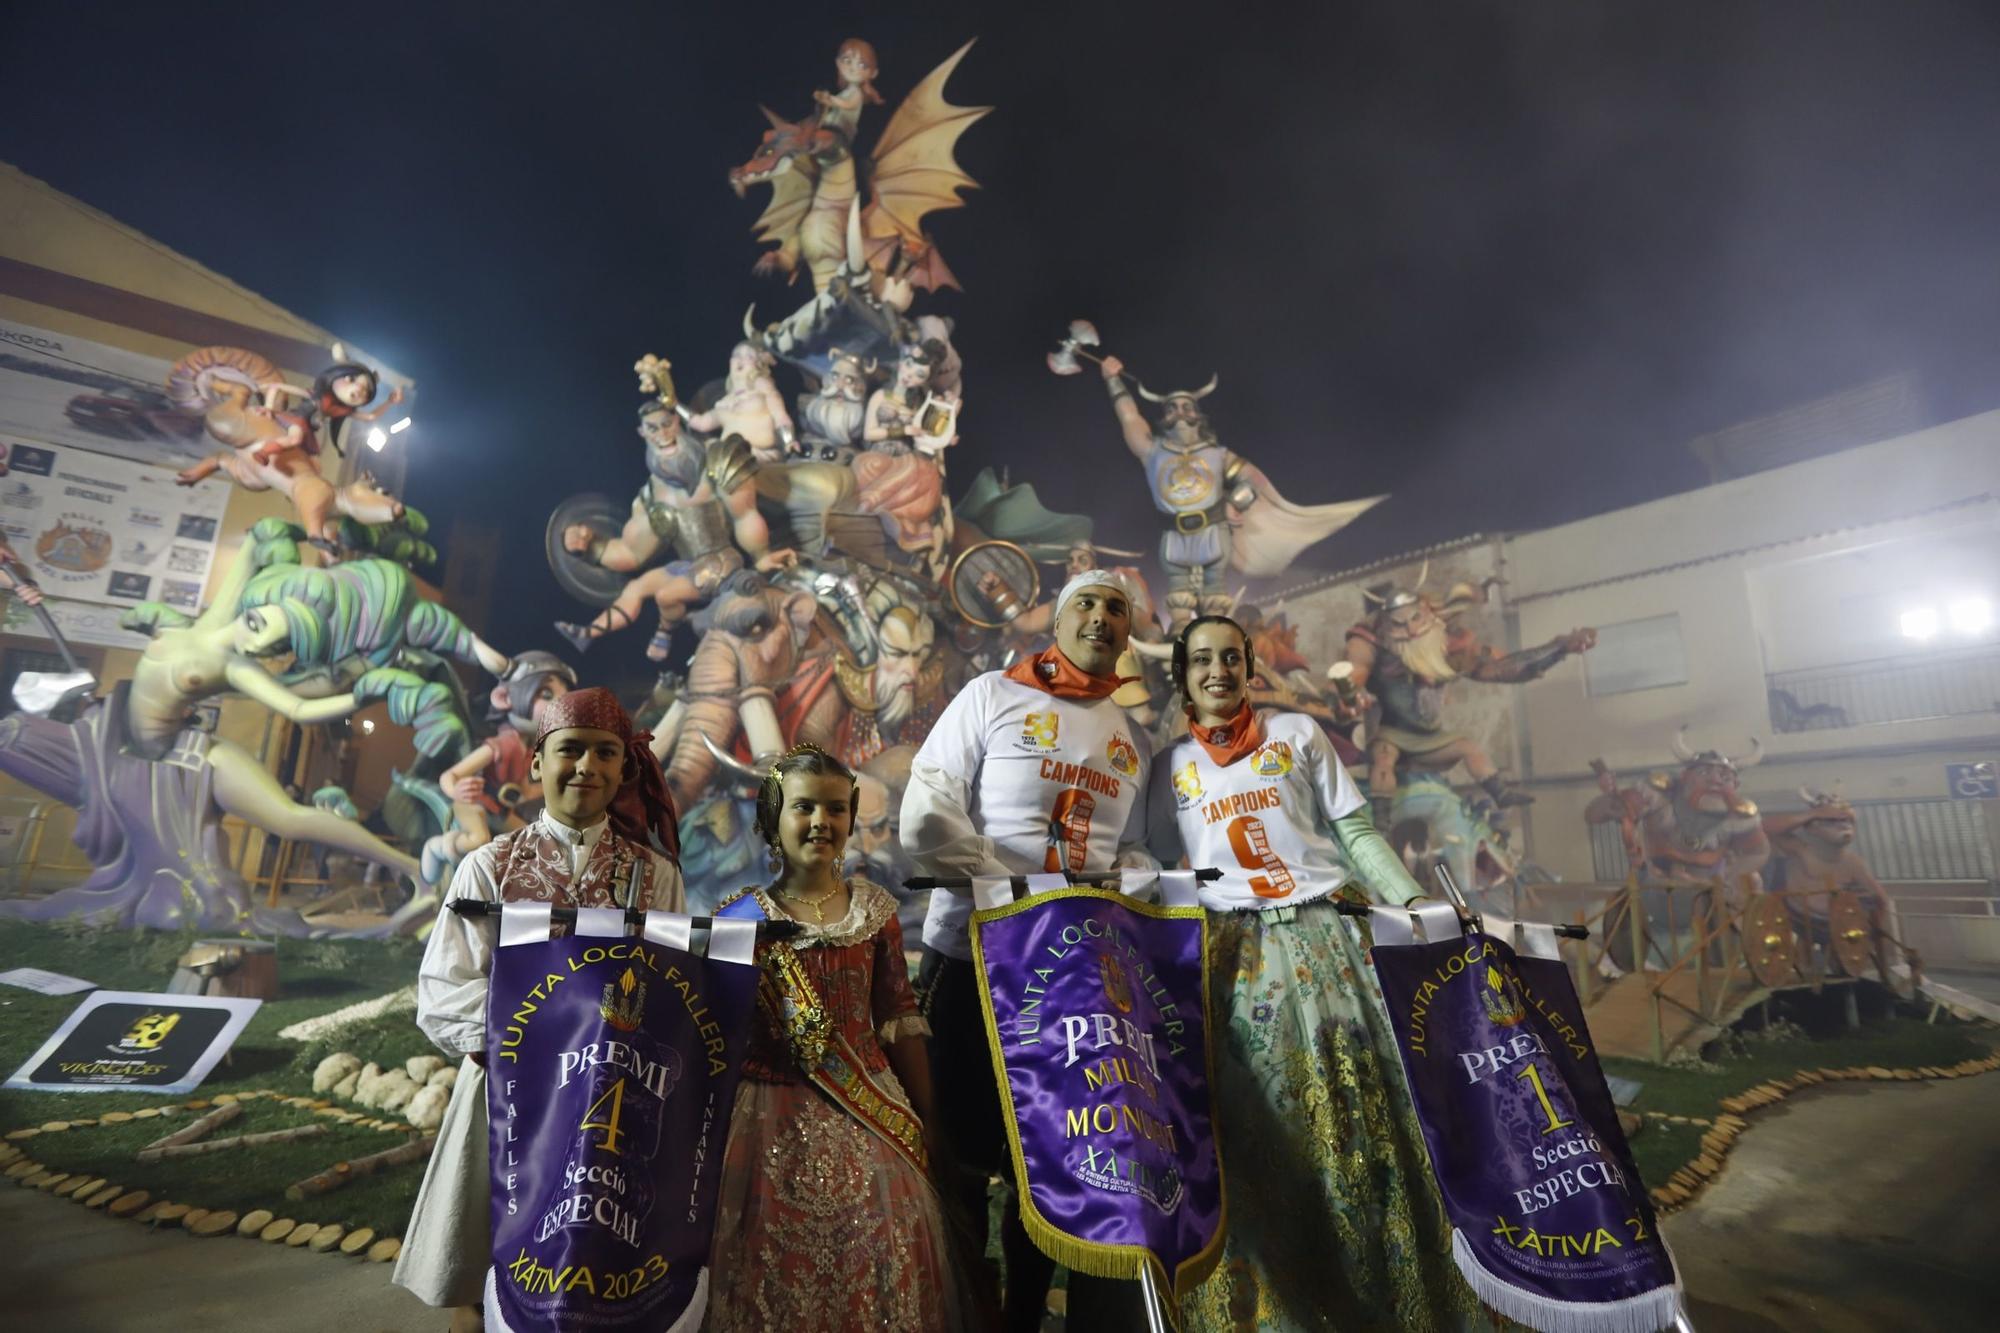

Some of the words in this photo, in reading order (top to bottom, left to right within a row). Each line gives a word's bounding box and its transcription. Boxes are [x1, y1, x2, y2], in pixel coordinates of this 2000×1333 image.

[1040, 757, 1120, 798] CAMPIONS
[1201, 786, 1281, 825] CAMPIONS
[499, 973, 565, 1064] JUNTA
[567, 944, 659, 973] LOCAL
[664, 966, 728, 1077] FALLERA
[1018, 968, 1055, 1046] JUNTA
[1047, 918, 1123, 959] LOCAL
[1127, 945, 1186, 1056] FALLERA
[1410, 980, 1440, 1058] JUNTA
[1436, 941, 1498, 983] LOCA
[558, 1040, 671, 1101] PREMI
[1458, 1033, 1551, 1085] PRE
[579, 1077, 626, 1155] 4
[1516, 1062, 1575, 1136] 1
[506, 1080, 519, 1216] FALLES
[687, 1092, 715, 1224] INFANTILS
[1532, 1132, 1601, 1171] Secció
[563, 1161, 627, 1196] Secció
[1084, 1176, 1102, 1188] FALLES
[1513, 1161, 1630, 1215] ESPECIA
[537, 1193, 642, 1248] ESPECIAL
[1492, 1215, 1623, 1257] XÀTIVA
[508, 1247, 596, 1295] XÀTIVA
[602, 1254, 669, 1300] 2023
